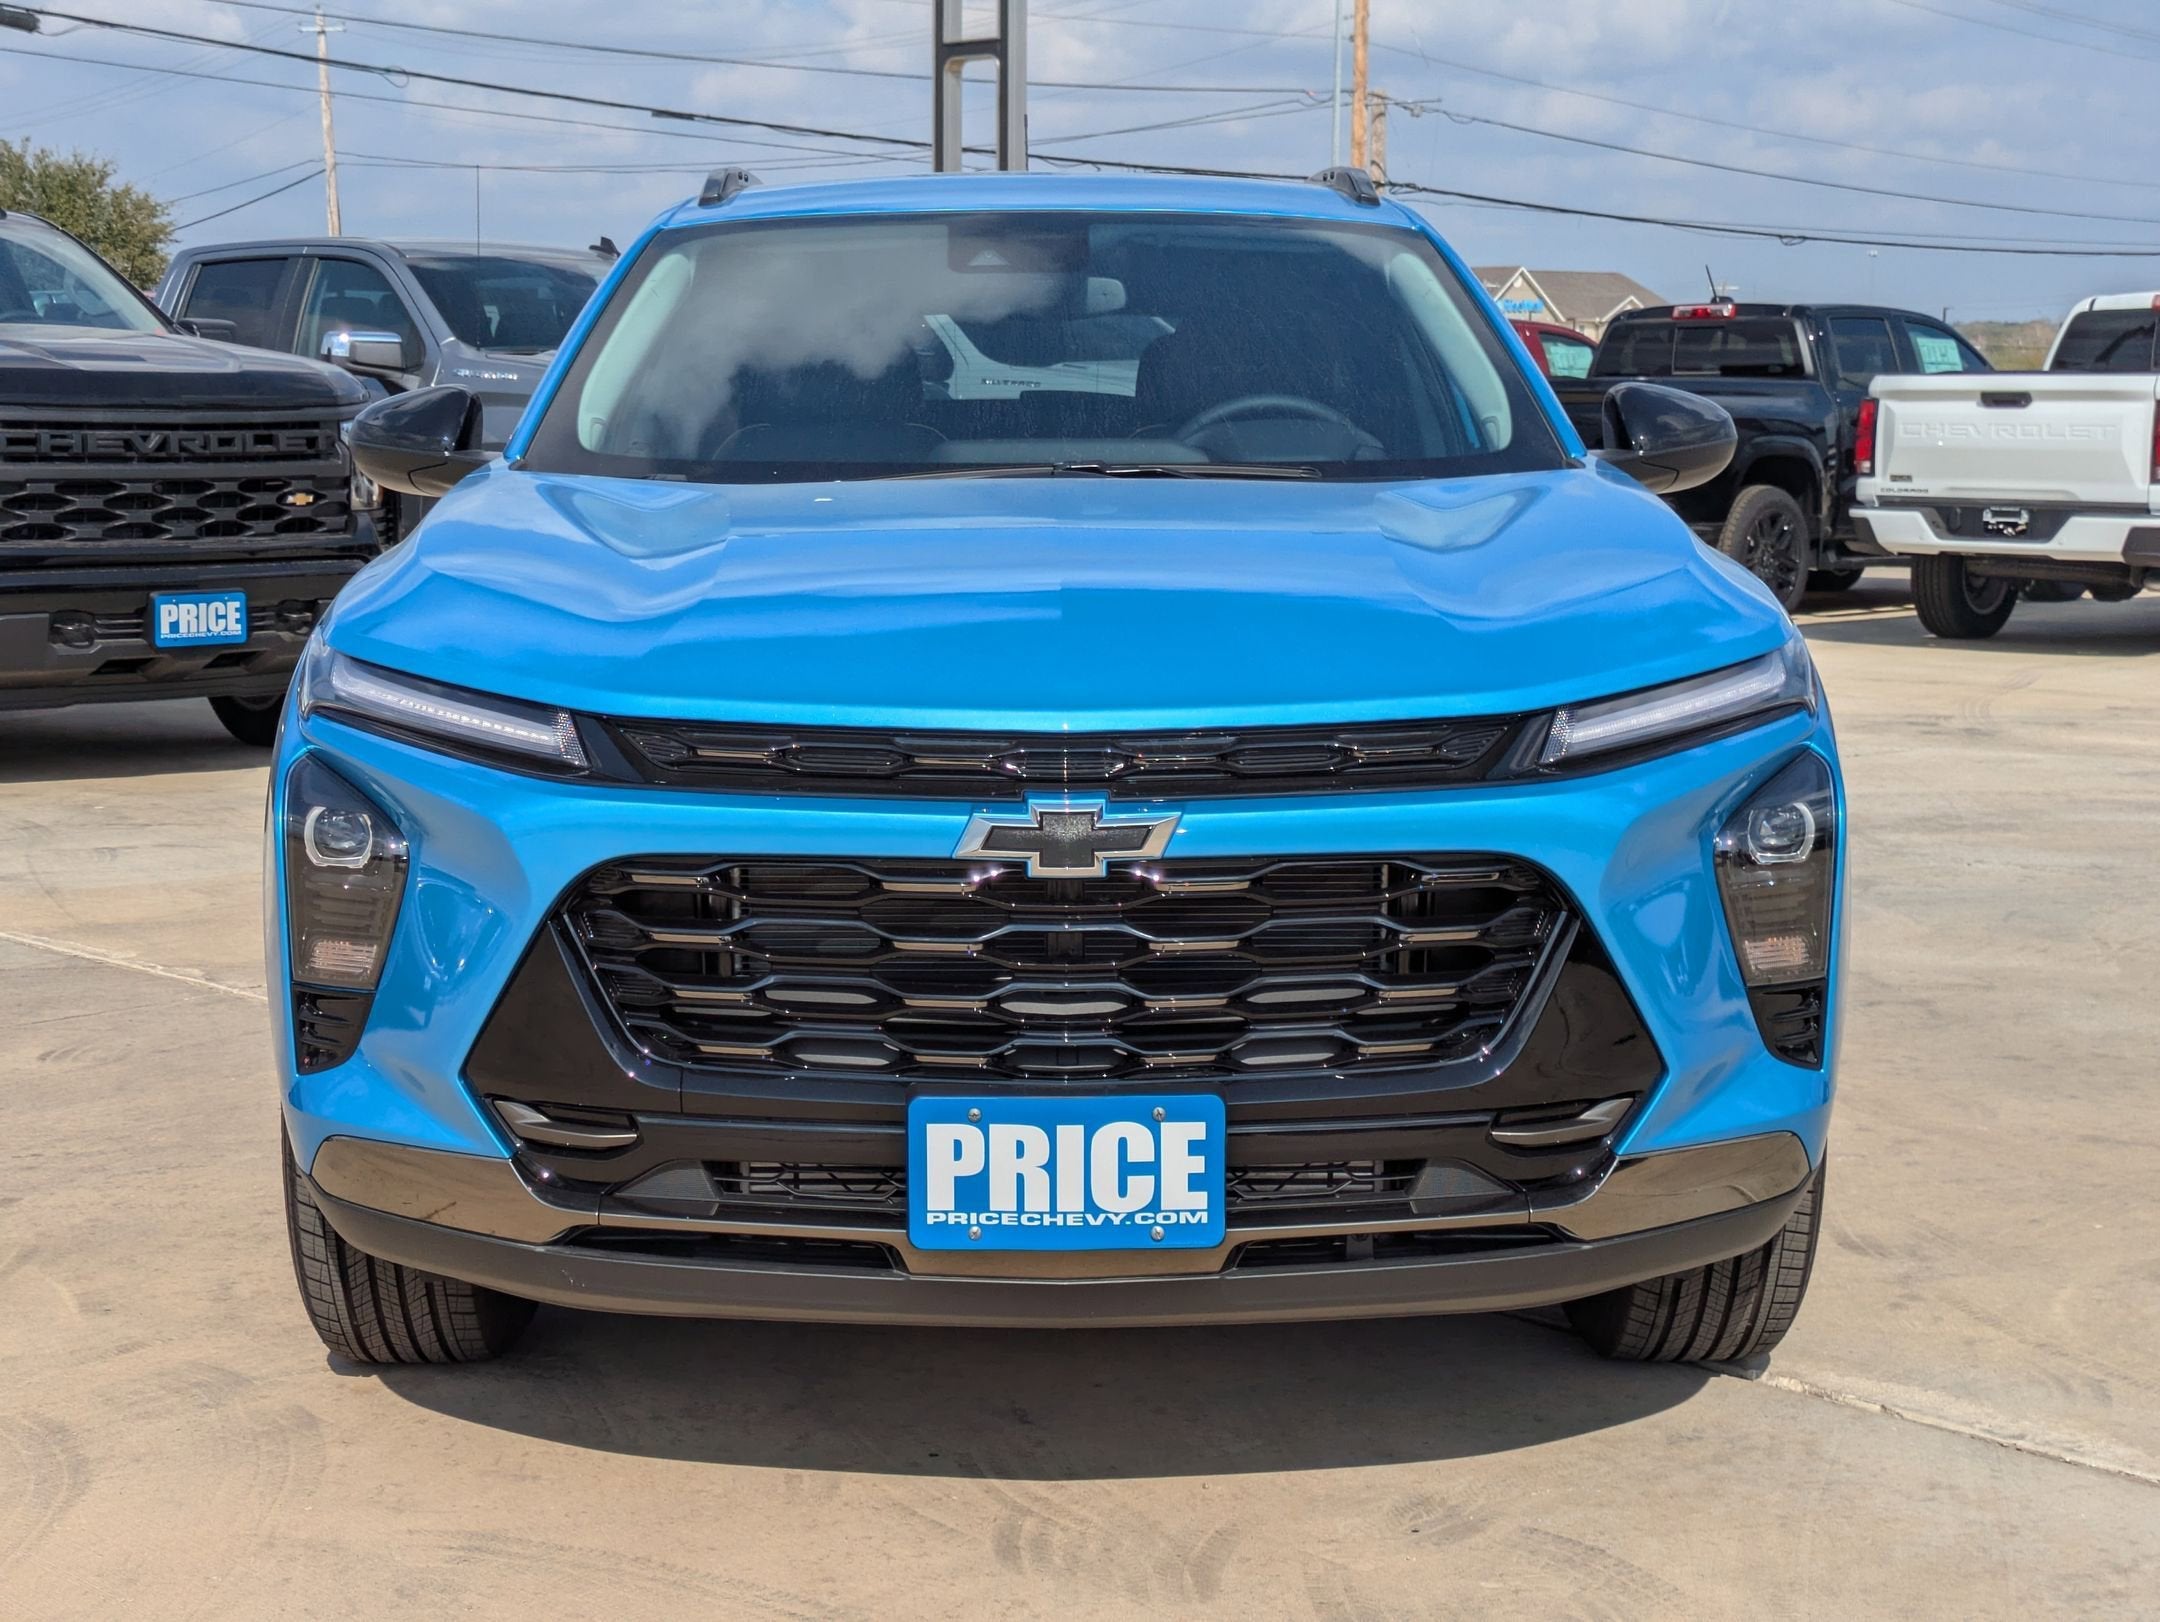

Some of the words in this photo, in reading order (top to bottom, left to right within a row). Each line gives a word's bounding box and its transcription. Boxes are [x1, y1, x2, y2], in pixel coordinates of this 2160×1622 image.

[1900, 422, 2116, 440] CHEVROLET
[160, 601, 242, 634] PRICE
[926, 1121, 1208, 1213] PRICE
[926, 1212, 1208, 1226] PRICECHEVY.COM
